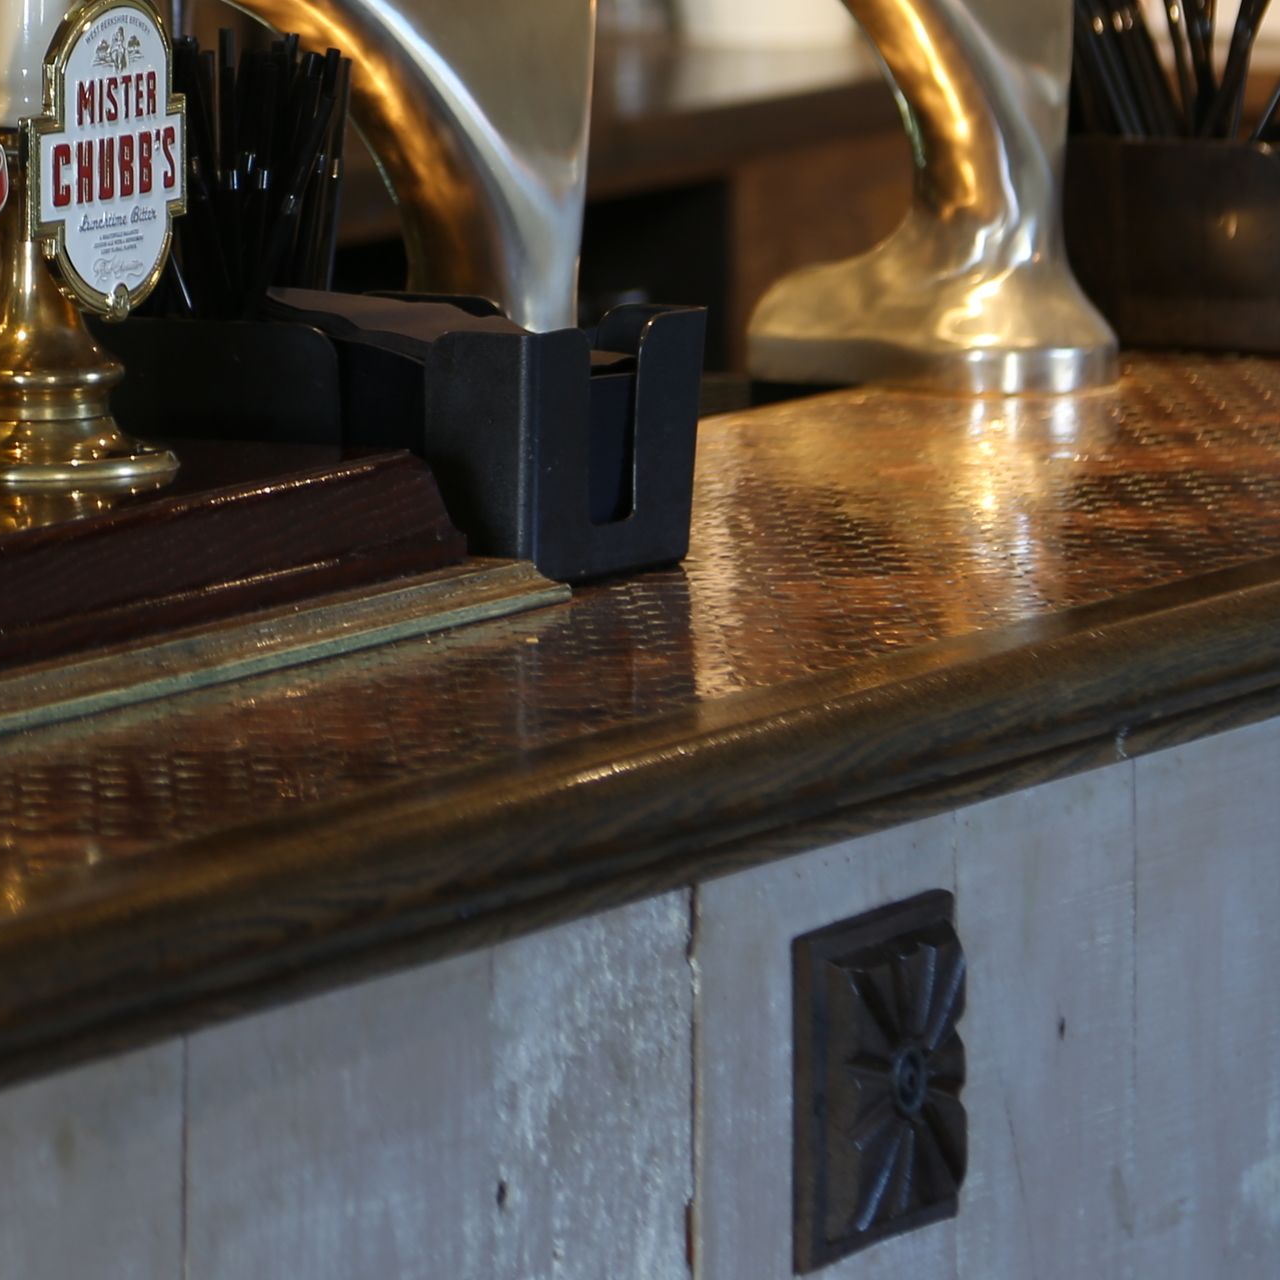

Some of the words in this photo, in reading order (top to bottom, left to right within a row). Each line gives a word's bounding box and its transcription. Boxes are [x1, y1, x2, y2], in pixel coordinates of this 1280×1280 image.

[85, 26, 102, 45] WEST
[100, 14, 128, 31] BERKSHIRE
[129, 15, 151, 35] BREWERY
[77, 71, 157, 126] MISTER
[52, 126, 176, 207] CHUBB'S
[79, 212, 127, 232] Lunchtime
[130, 205, 158, 224] Bitter
